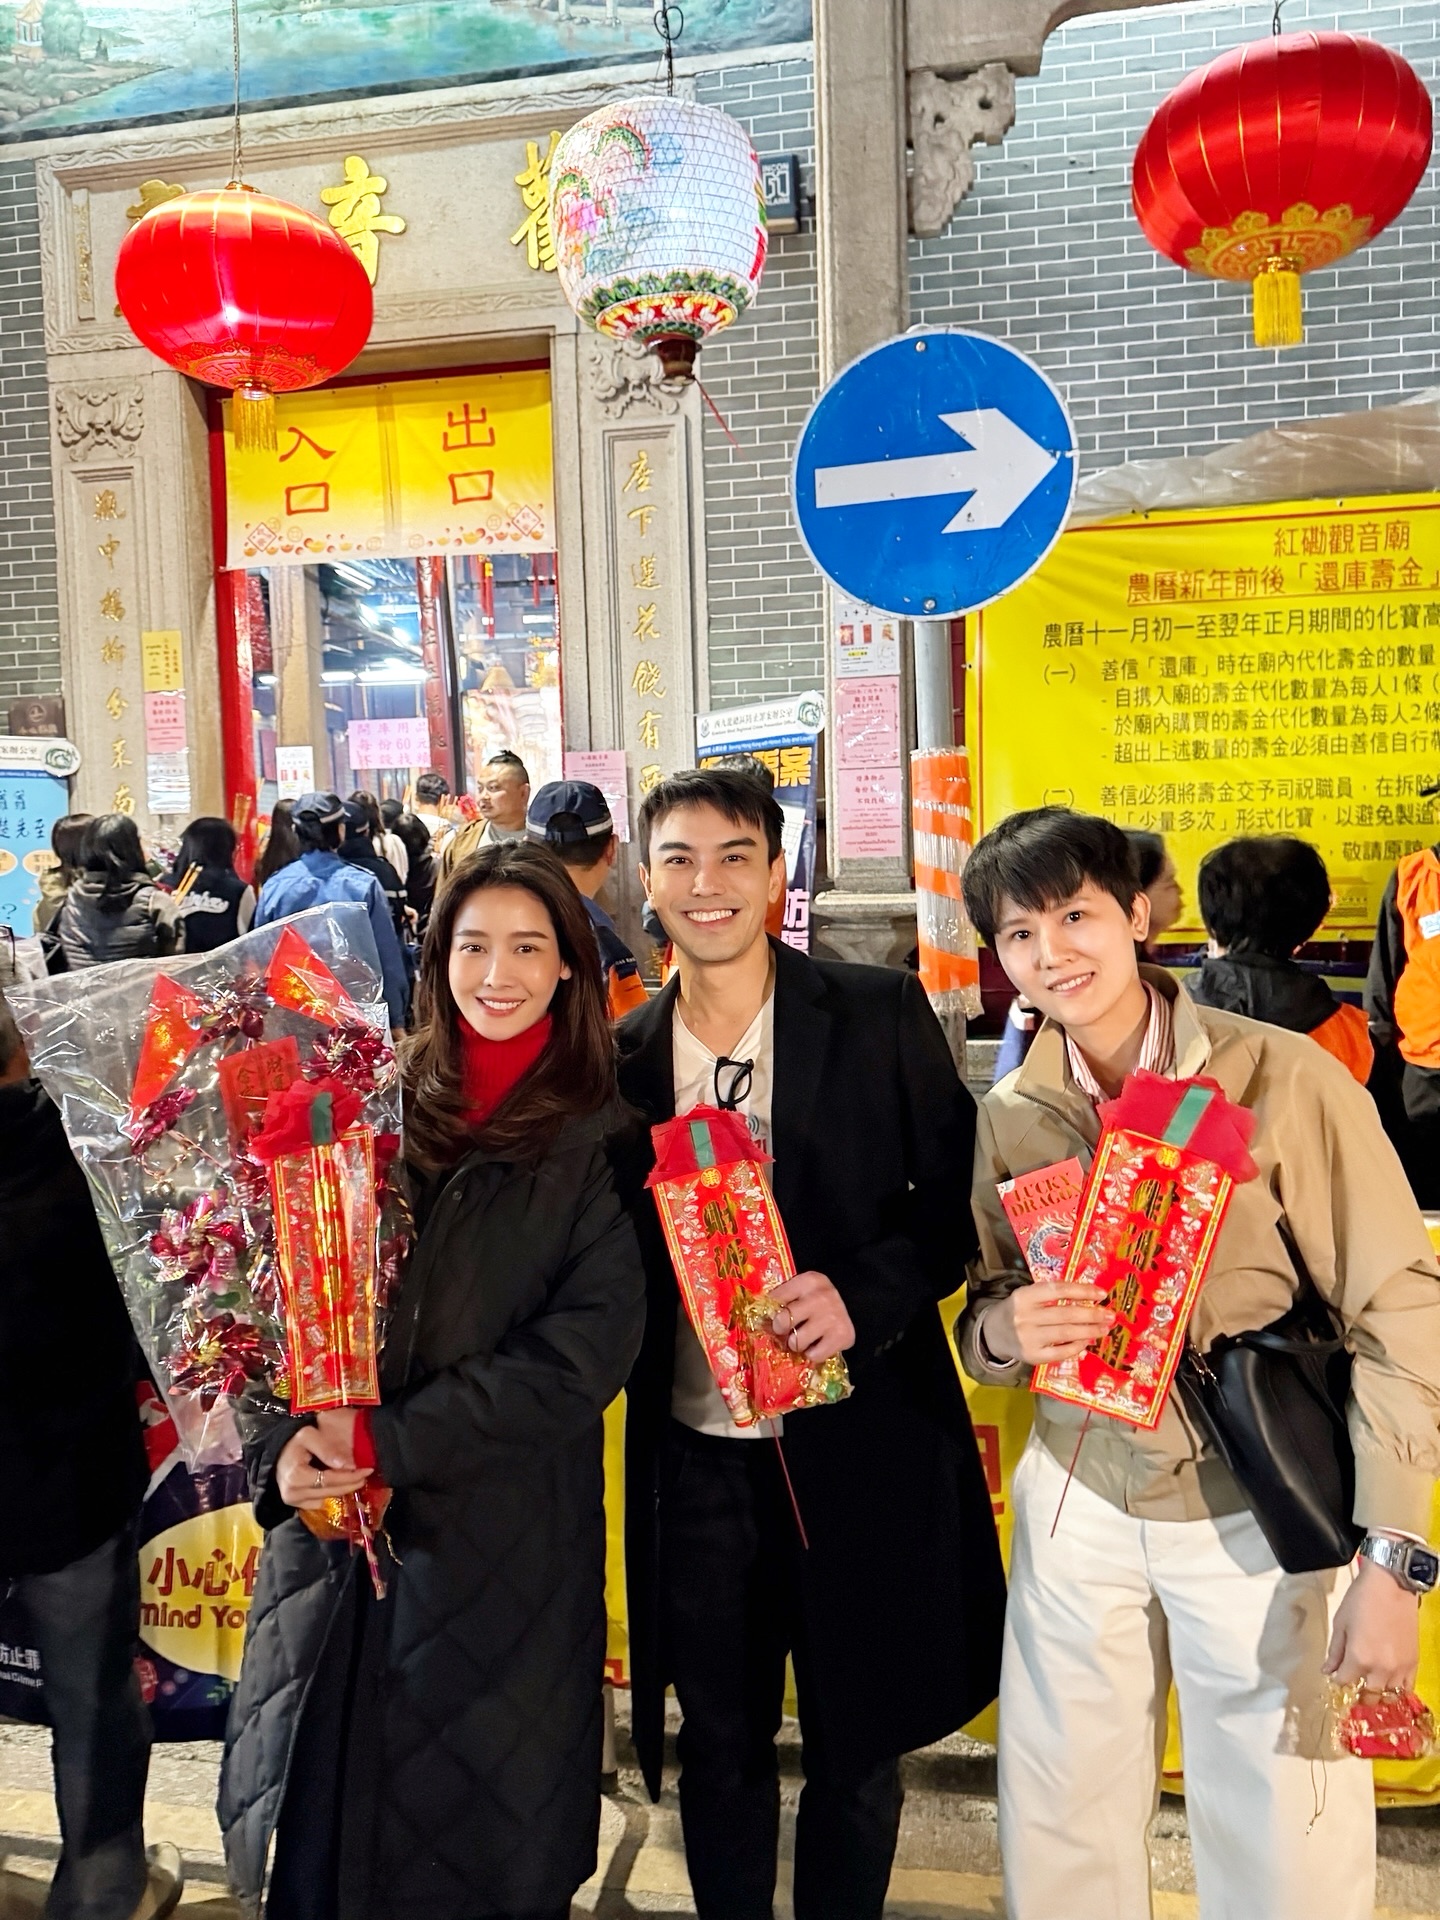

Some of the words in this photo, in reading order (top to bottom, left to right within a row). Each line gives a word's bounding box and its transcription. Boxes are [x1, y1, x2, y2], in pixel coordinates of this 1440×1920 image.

[279, 426, 336, 516] 入口
[442, 403, 495, 505] 出口
[1273, 520, 1411, 557] 紅磡觀音廟
[1014, 1173, 1071, 1202] LUCKY
[210, 1606, 249, 1629] Yo
